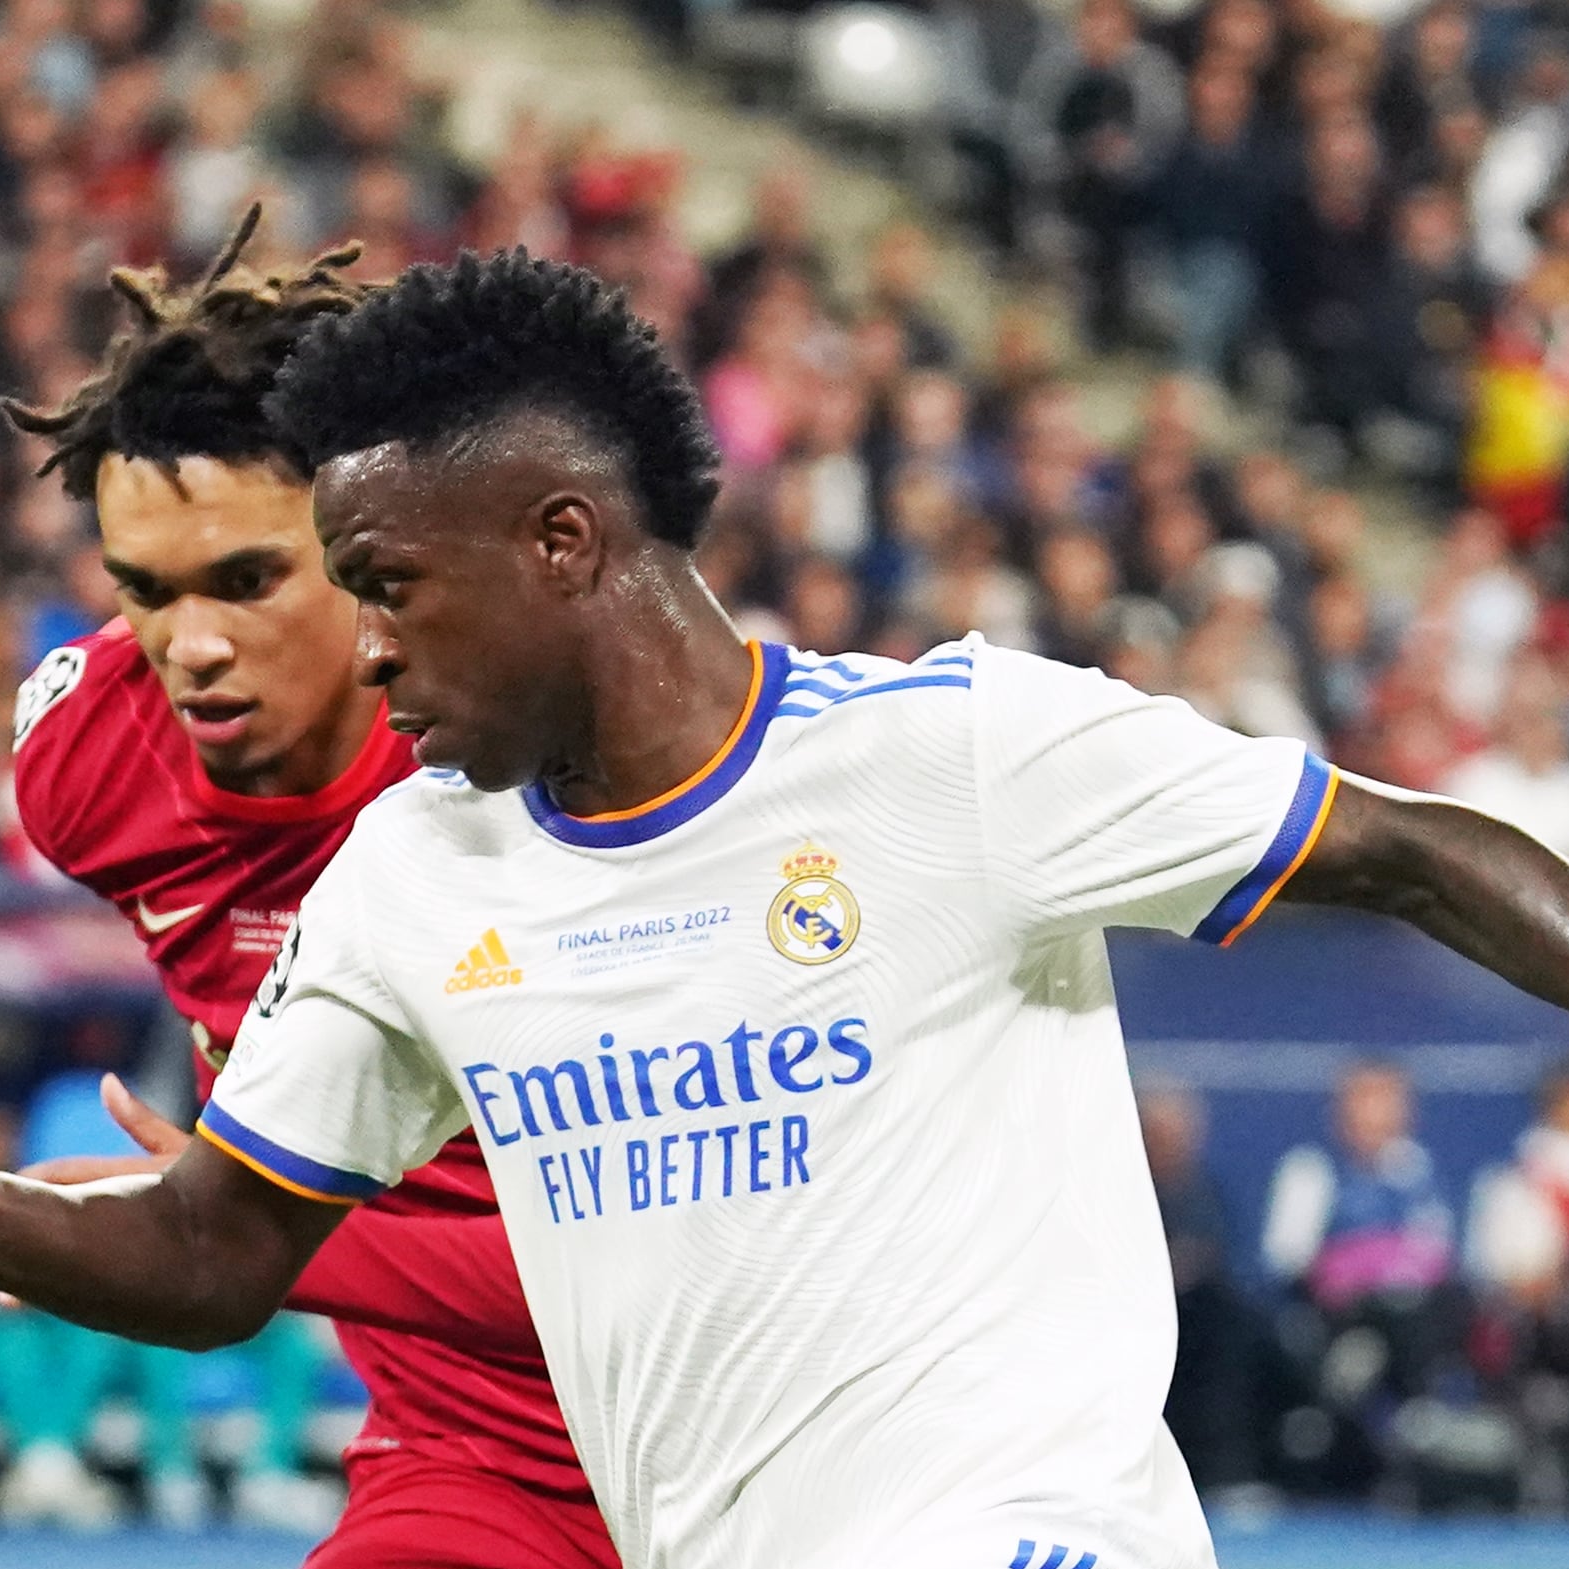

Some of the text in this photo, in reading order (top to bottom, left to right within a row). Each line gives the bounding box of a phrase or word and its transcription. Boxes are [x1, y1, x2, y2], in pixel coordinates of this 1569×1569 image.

[270, 910, 298, 927] PAR
[558, 906, 731, 950] FINAL PARIS 2022
[444, 967, 524, 994] adidas
[461, 1018, 872, 1146] Emirates
[538, 1114, 811, 1224] FLY BETTER
